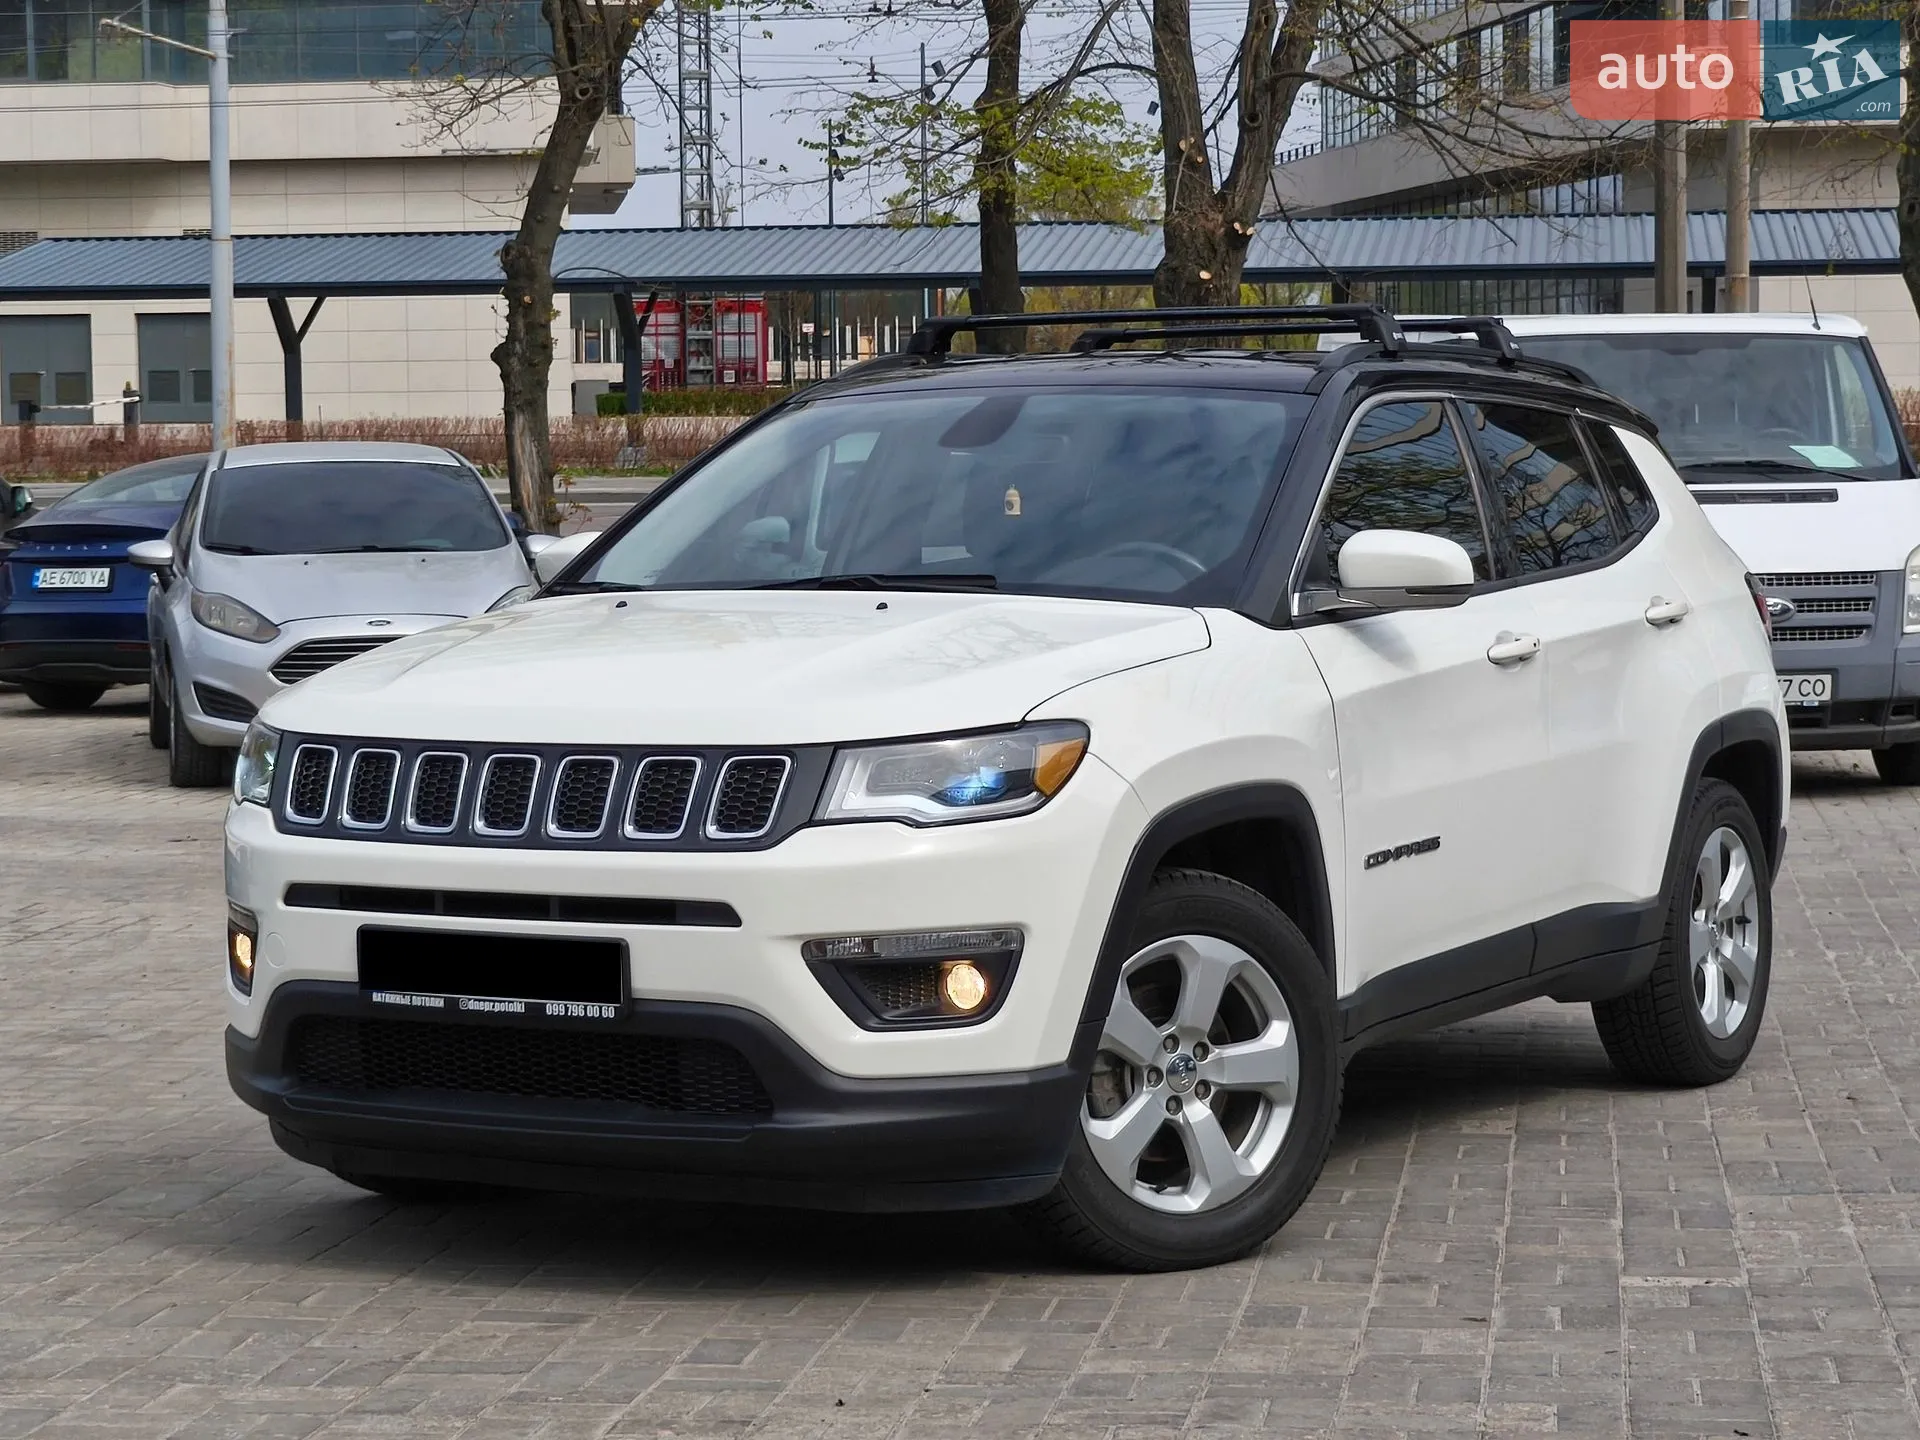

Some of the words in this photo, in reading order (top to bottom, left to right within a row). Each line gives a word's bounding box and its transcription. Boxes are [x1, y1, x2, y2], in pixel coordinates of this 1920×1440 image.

[41, 572, 57, 585] AE
[59, 572, 86, 585] 6700
[90, 571, 106, 585] YA
[1798, 679, 1826, 697] CO
[1363, 835, 1441, 870] COMPASS
[545, 1003, 565, 1016] 099
[567, 1004, 585, 1017] 796
[587, 1005, 600, 1018] 00
[601, 1006, 615, 1019] 60
